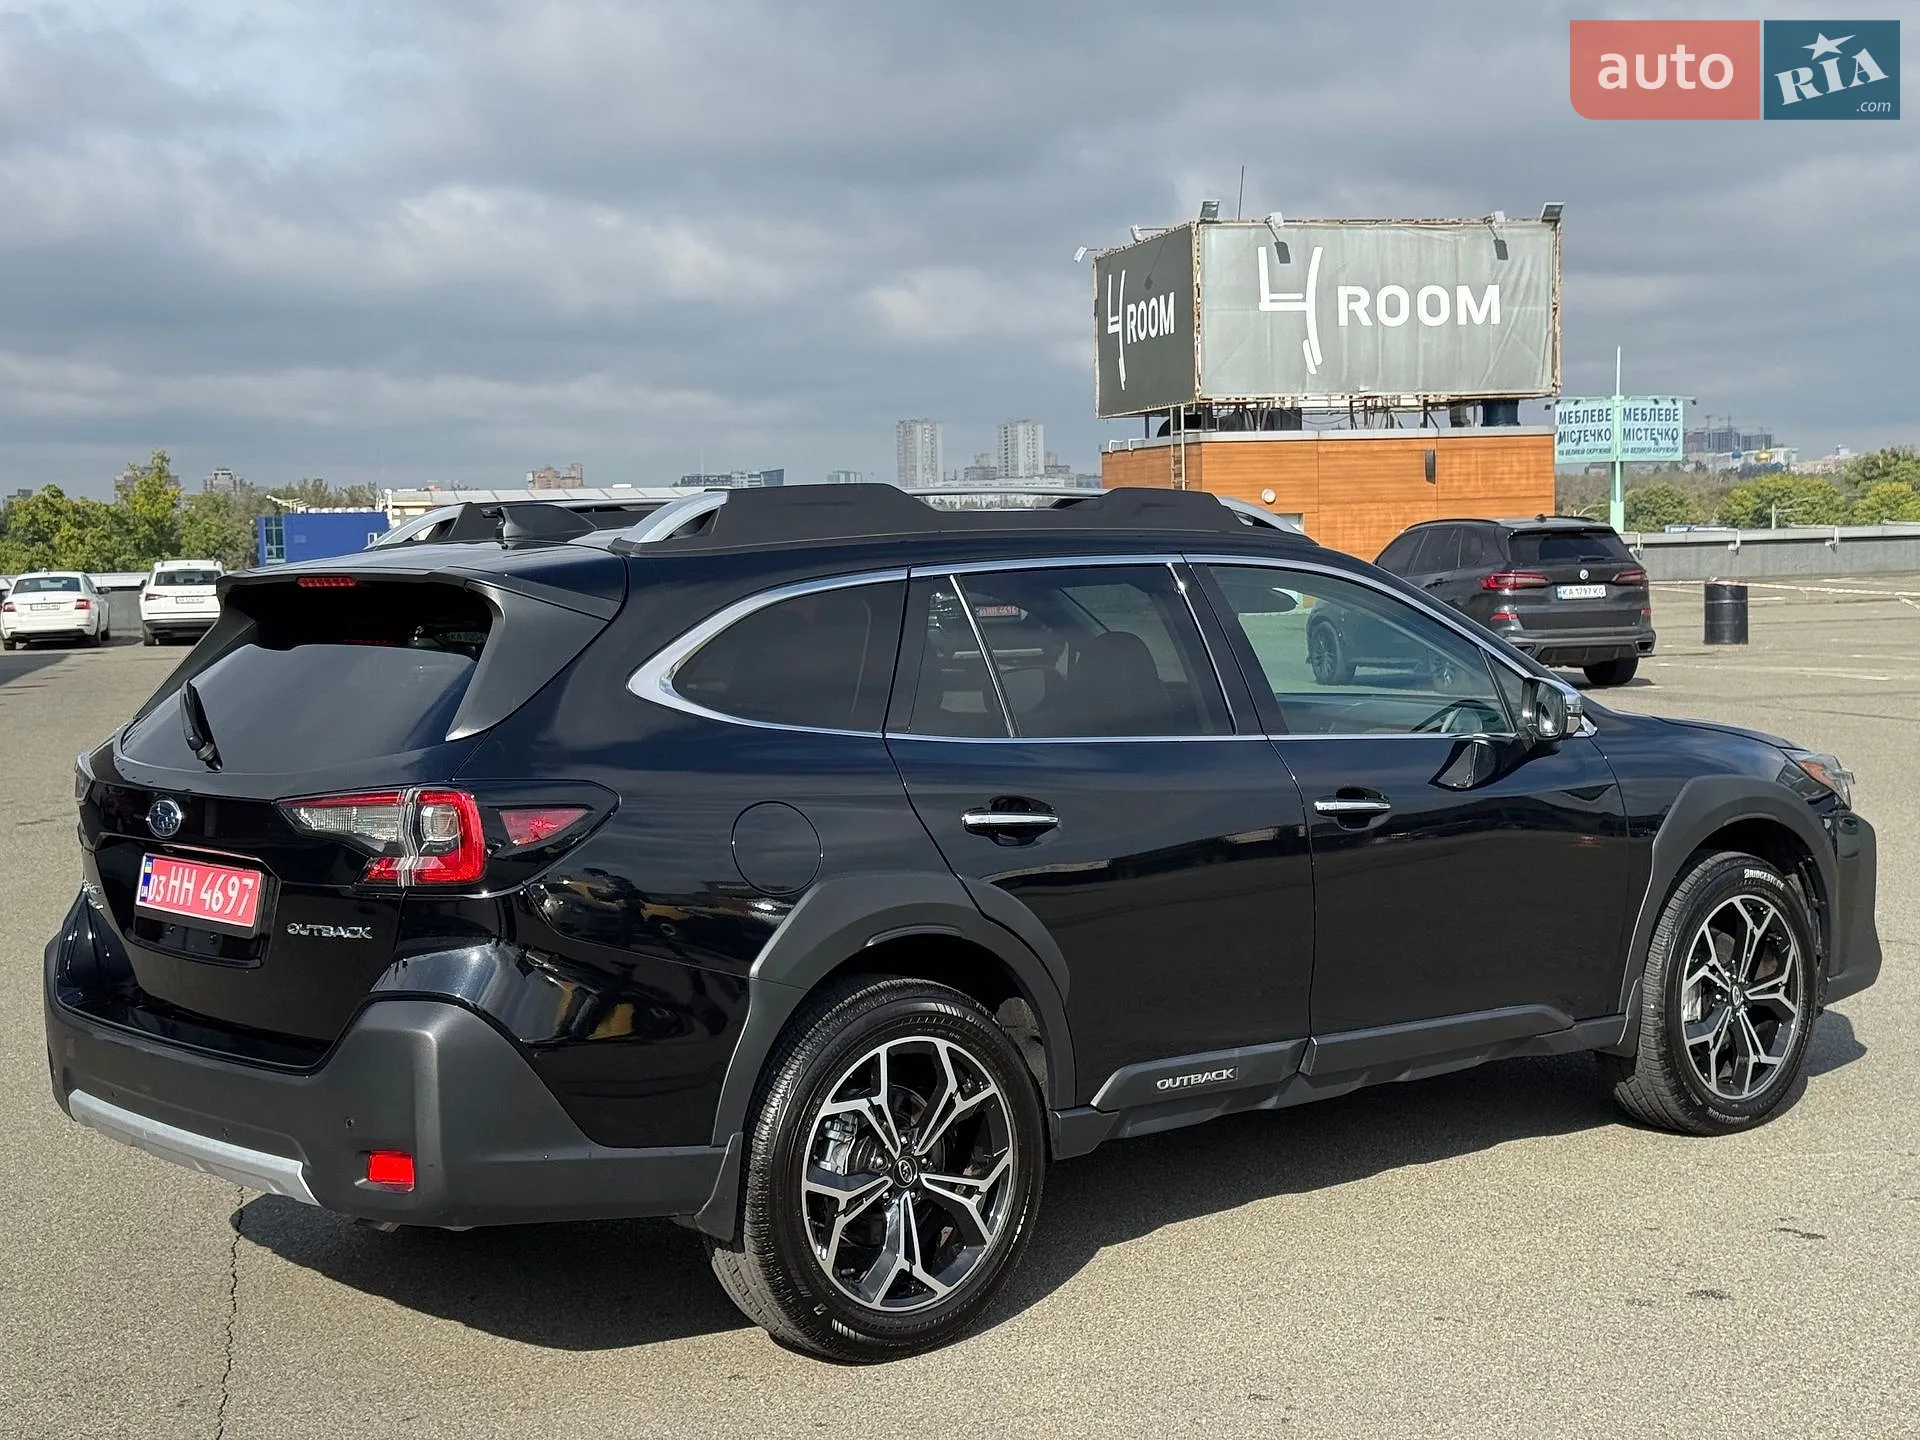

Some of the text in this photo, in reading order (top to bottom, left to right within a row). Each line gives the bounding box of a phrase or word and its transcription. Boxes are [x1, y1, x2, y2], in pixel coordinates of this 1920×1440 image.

[1338, 284, 1501, 327] ROOM
[1126, 291, 1175, 345] ROOM
[1559, 407, 1612, 425] МЕБЛЕВЕ
[1623, 407, 1679, 422] МЕБЛЕВЕ
[1558, 428, 1612, 444] МІСТЕЧКО
[1623, 427, 1679, 442] МІСТЕЧКО
[1744, 868, 1784, 891] BRIDGESTONE
[200, 871, 254, 917] 4697
[286, 922, 373, 939] OUTBACK
[1157, 1068, 1235, 1090] OUTBACK
